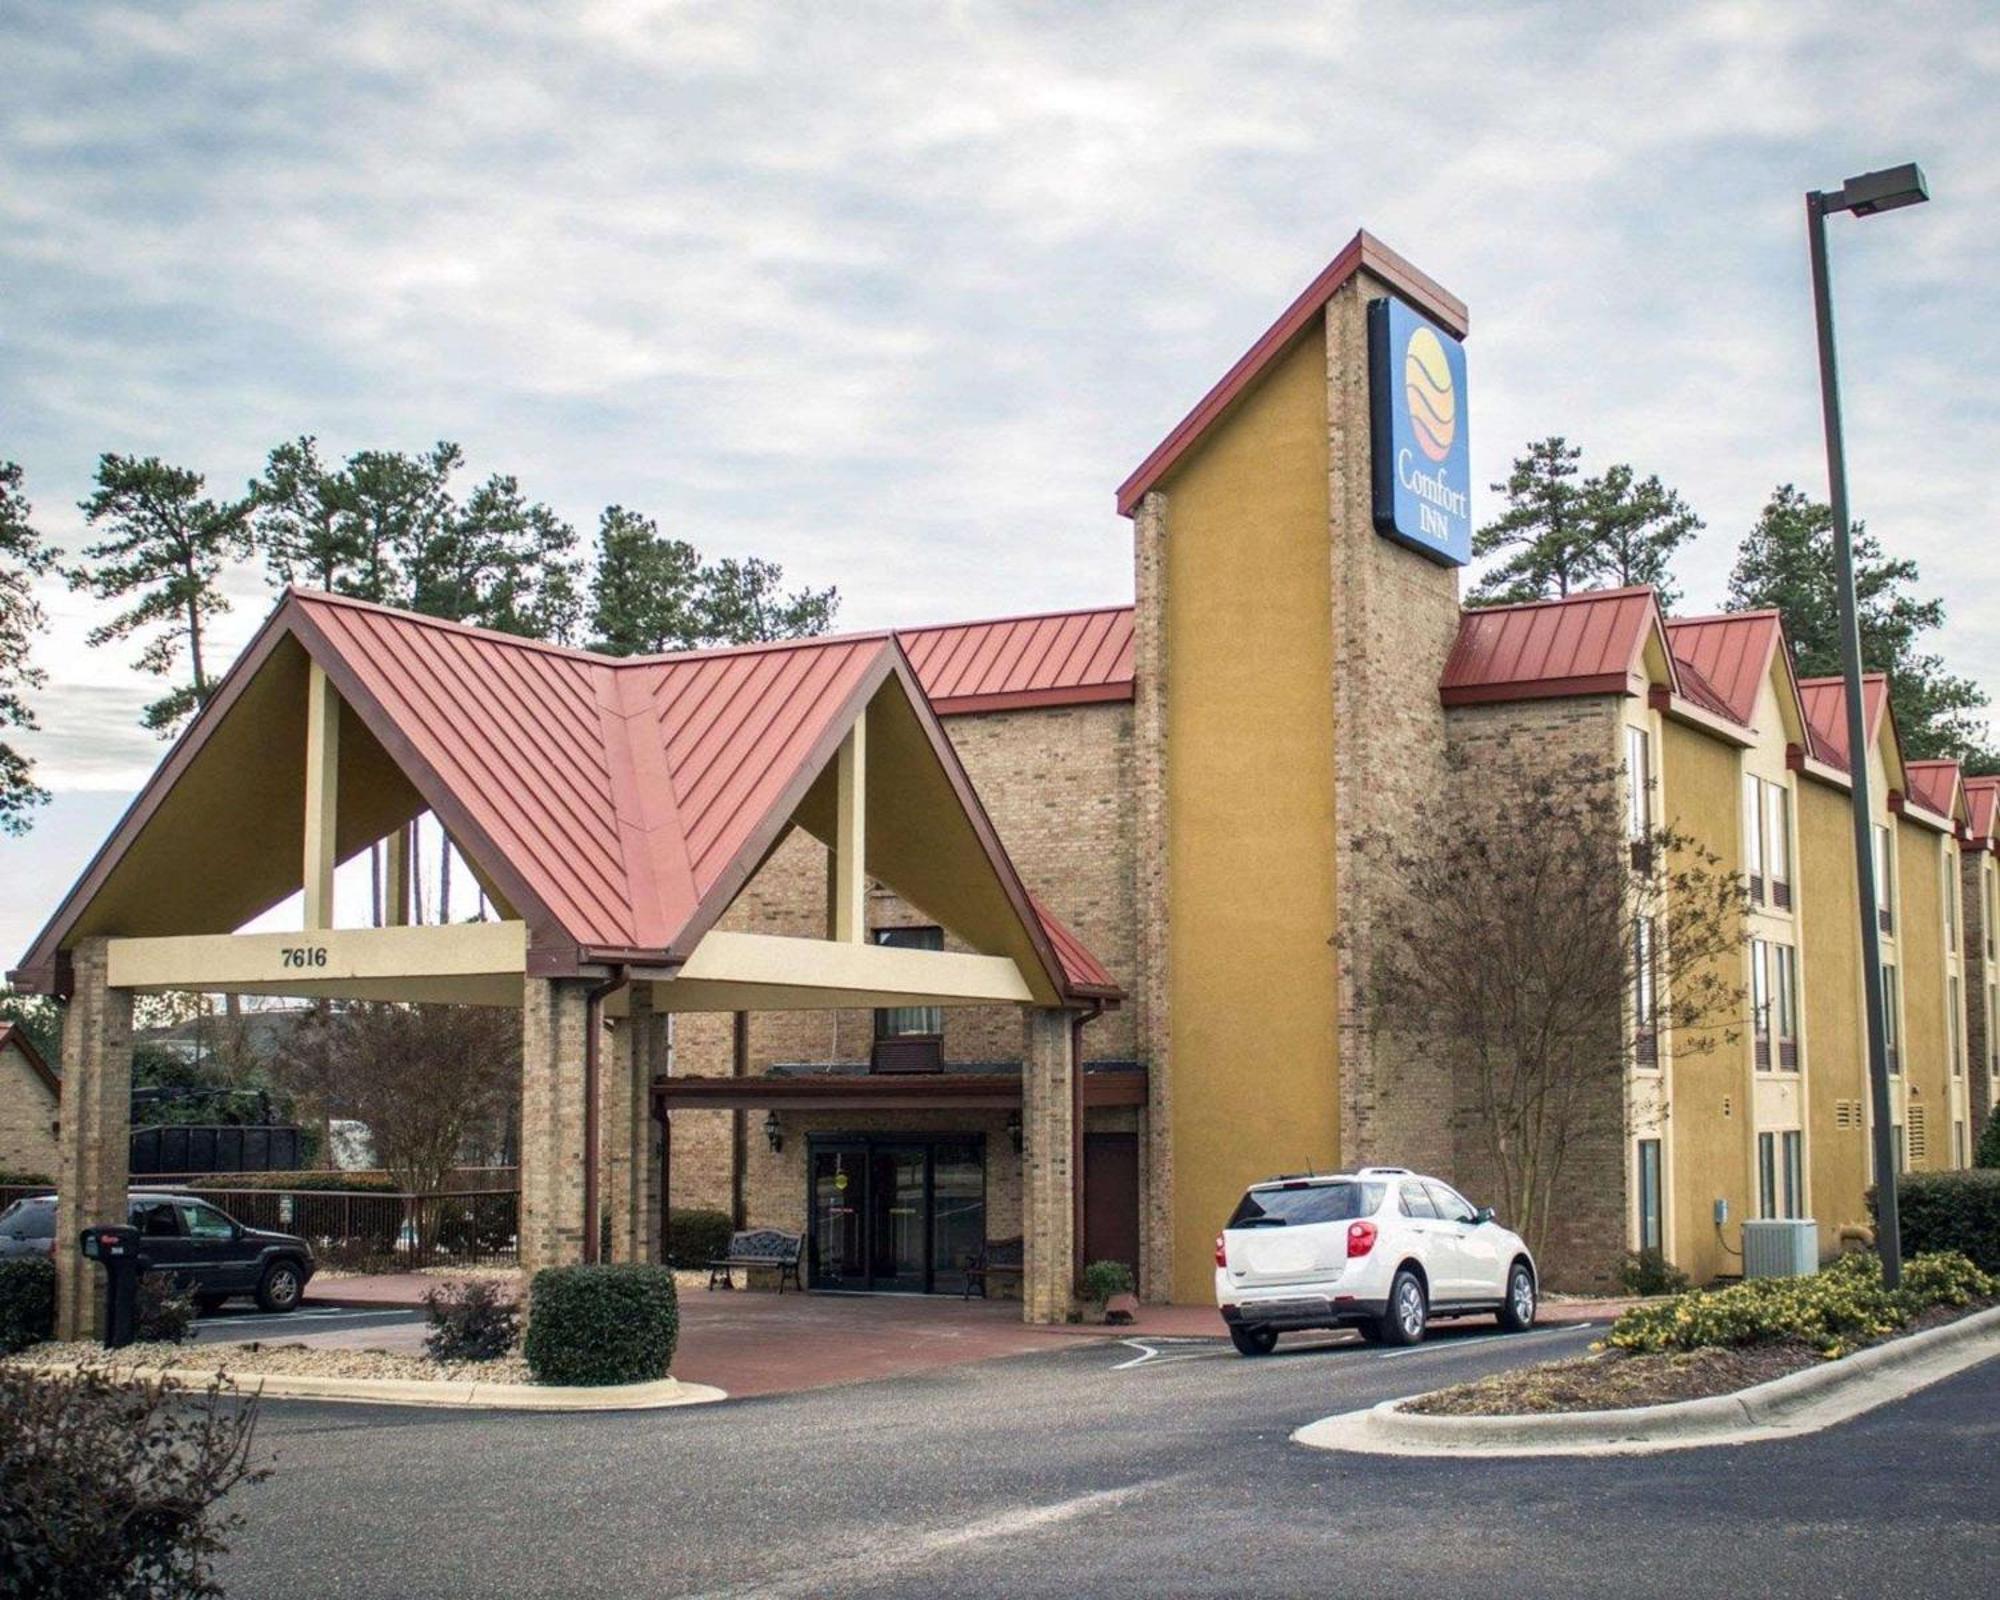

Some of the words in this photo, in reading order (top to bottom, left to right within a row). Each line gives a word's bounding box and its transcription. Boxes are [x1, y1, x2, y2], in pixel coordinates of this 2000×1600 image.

[1399, 447, 1466, 519] Comfort
[1420, 502, 1448, 541] INN
[281, 946, 327, 968] 7616
